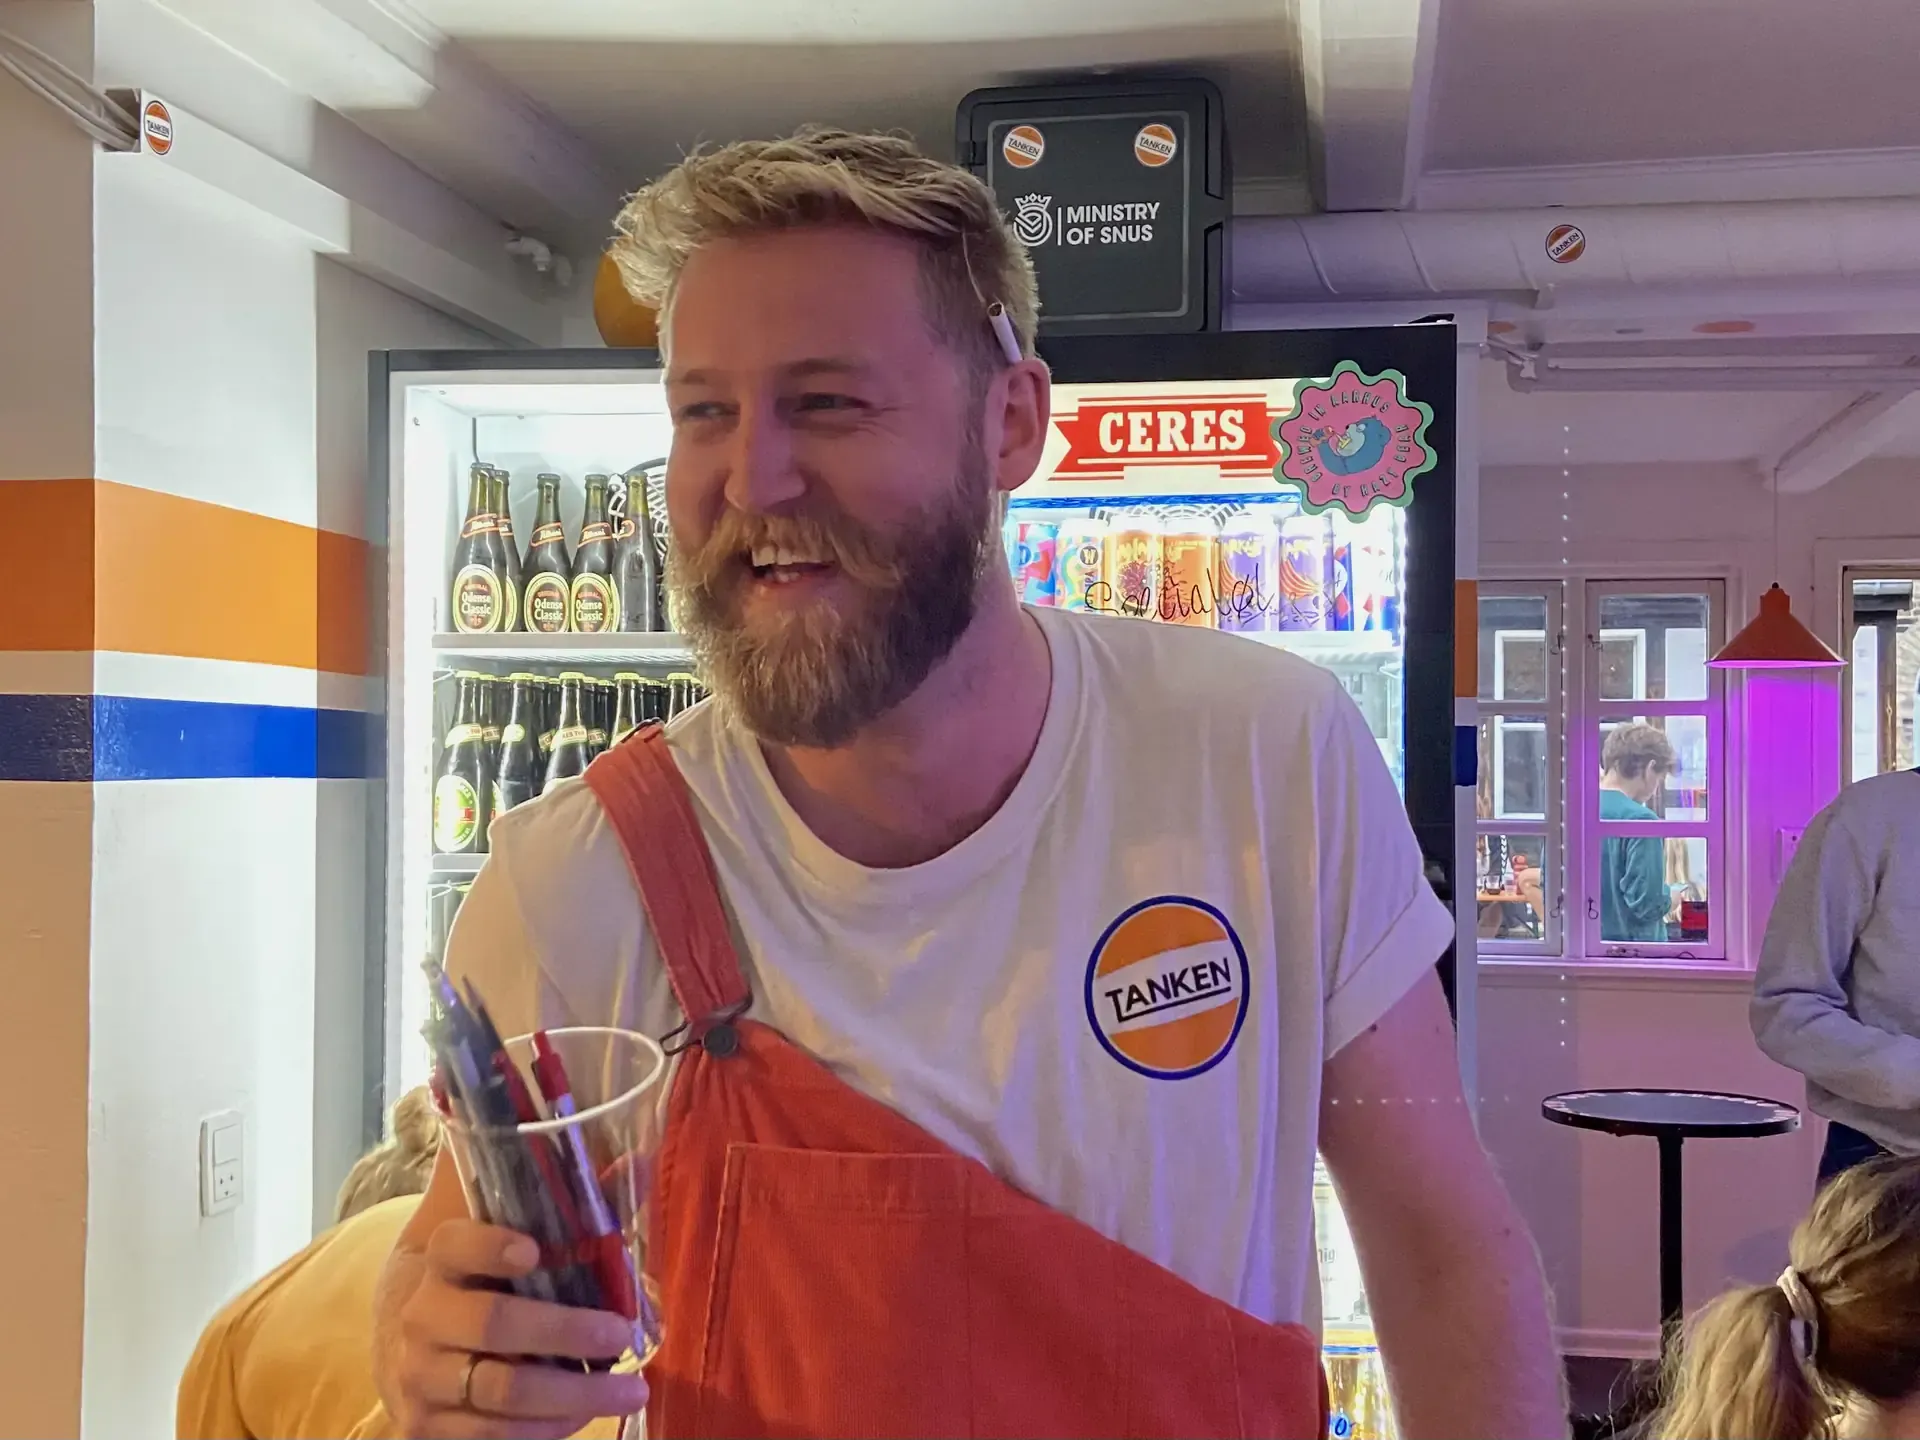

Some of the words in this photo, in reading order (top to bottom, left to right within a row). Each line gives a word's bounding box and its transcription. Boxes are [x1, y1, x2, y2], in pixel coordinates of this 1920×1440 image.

[147, 120, 169, 138] TANKEN
[1009, 137, 1040, 157] TANKEN
[1140, 136, 1172, 155] TANKEN
[1066, 202, 1160, 223] MINISTRY
[1066, 228, 1094, 246] OF
[1100, 224, 1153, 245] SNUS
[1552, 232, 1580, 256] TANKEN
[1331, 389, 1390, 413] AARHUS
[1308, 404, 1326, 421] IN
[1099, 409, 1246, 453] CERES
[1298, 425, 1323, 483] BREWED
[1332, 483, 1350, 498] BY
[1360, 467, 1399, 497] HAZY
[1395, 424, 1411, 463] BEAR
[462, 592, 491, 604] Odense
[534, 598, 563, 610] Odense
[576, 600, 603, 611] Odense
[462, 603, 491, 615] Classic
[534, 609, 563, 621] Classic
[576, 610, 603, 621] Classic
[1105, 957, 1231, 1023] TANKEN
